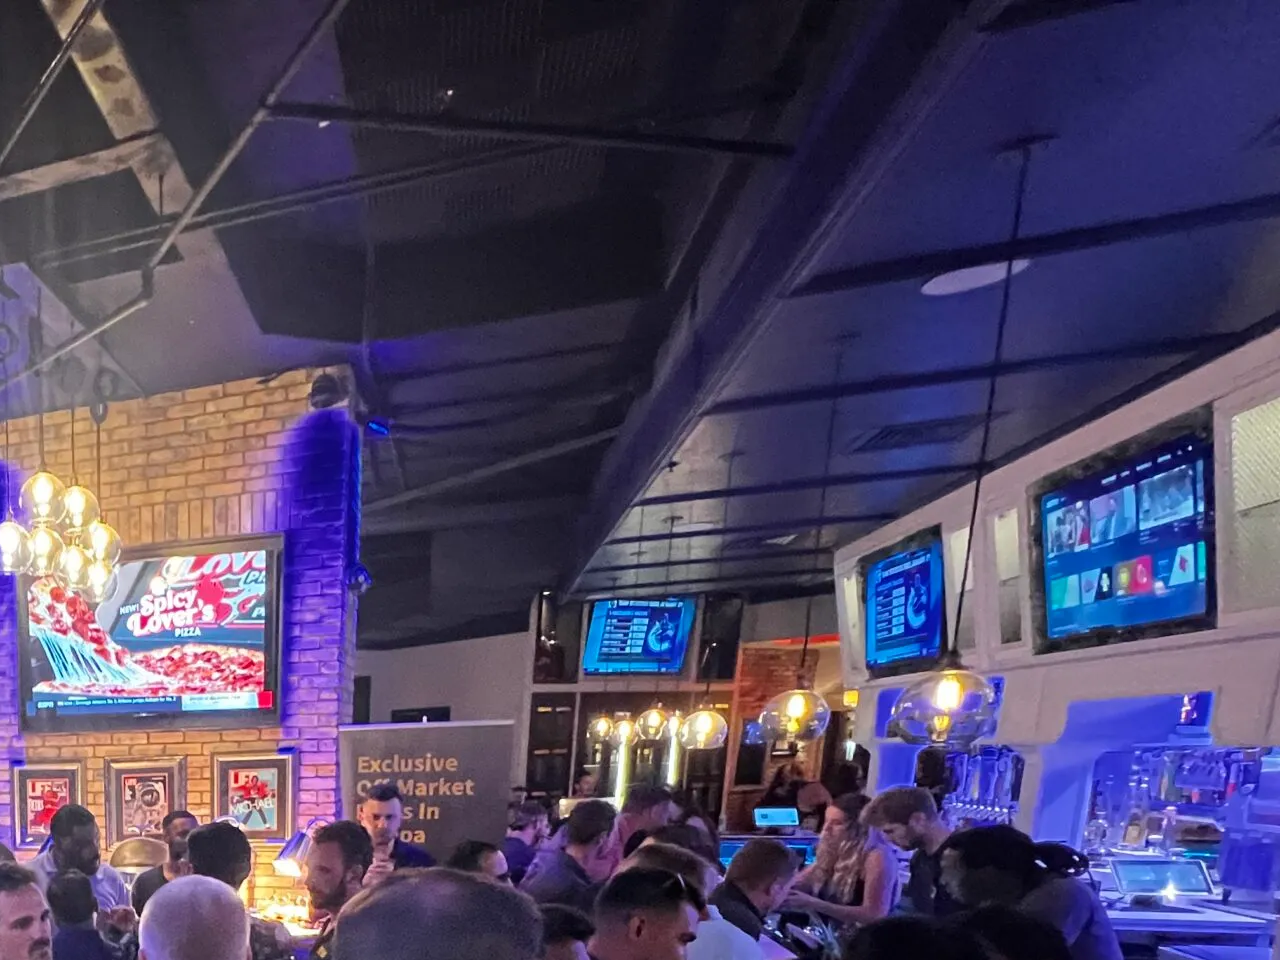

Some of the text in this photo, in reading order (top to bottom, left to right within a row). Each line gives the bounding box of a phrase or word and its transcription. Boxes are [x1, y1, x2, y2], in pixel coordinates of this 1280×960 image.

[119, 604, 140, 616] NEW!
[140, 588, 197, 614] Spicy
[126, 598, 216, 637] Lover's
[174, 626, 202, 637] PIZZA
[356, 753, 459, 773] Exclusive
[419, 802, 440, 820] In
